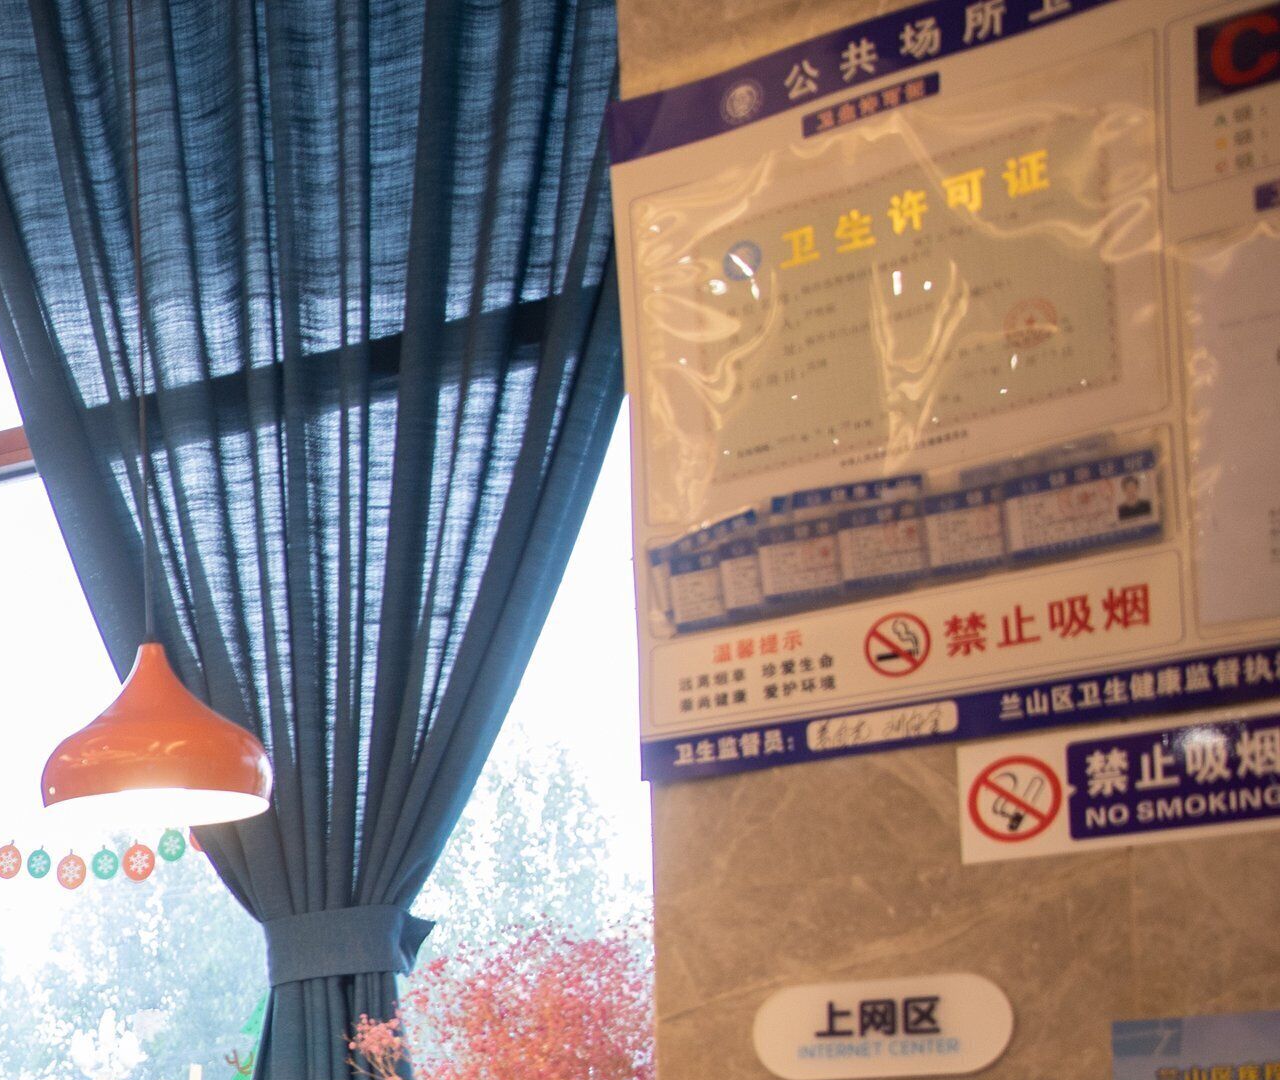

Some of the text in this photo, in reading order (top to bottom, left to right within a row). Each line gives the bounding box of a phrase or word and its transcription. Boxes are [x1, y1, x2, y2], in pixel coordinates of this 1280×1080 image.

[779, 150, 1051, 270] 卫生许可证
[943, 582, 1153, 660] 禁止吸烟
[712, 630, 804, 664] 温馨提示
[762, 653, 834, 679] 珍爱生命
[763, 674, 837, 701] 爱护环境
[1084, 727, 1280, 798] 禁止吸烟
[1085, 784, 1280, 829] NO SMOKING
[813, 994, 943, 1039] 上网区
[797, 1036, 961, 1060] INTERNET CENTER
